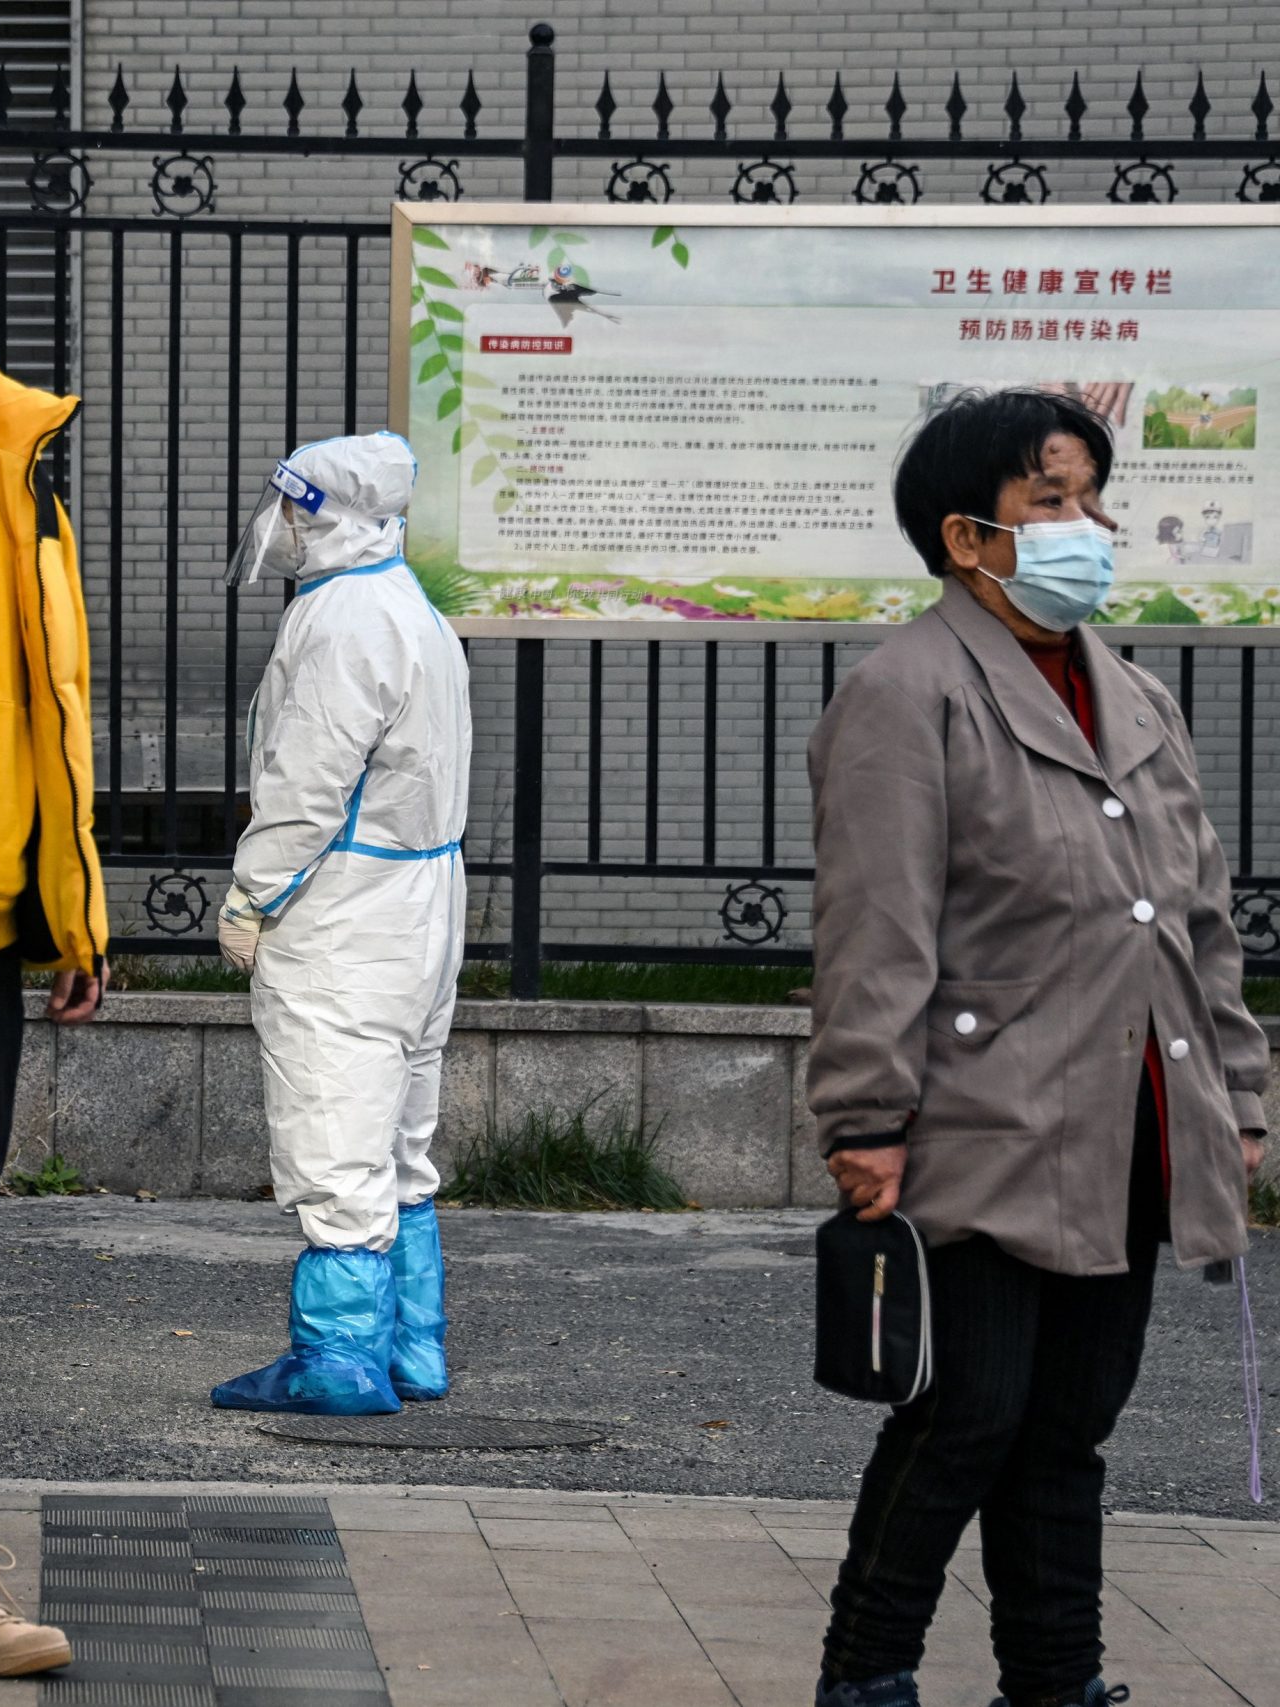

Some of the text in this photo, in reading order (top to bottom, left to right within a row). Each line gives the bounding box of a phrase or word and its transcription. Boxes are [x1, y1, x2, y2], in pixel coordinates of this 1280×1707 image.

[930, 267, 1173, 296] 卫生健康宣传栏
[959, 319, 1139, 341] 预防肠道传染病
[488, 339, 565, 351] 传染病防控知识
